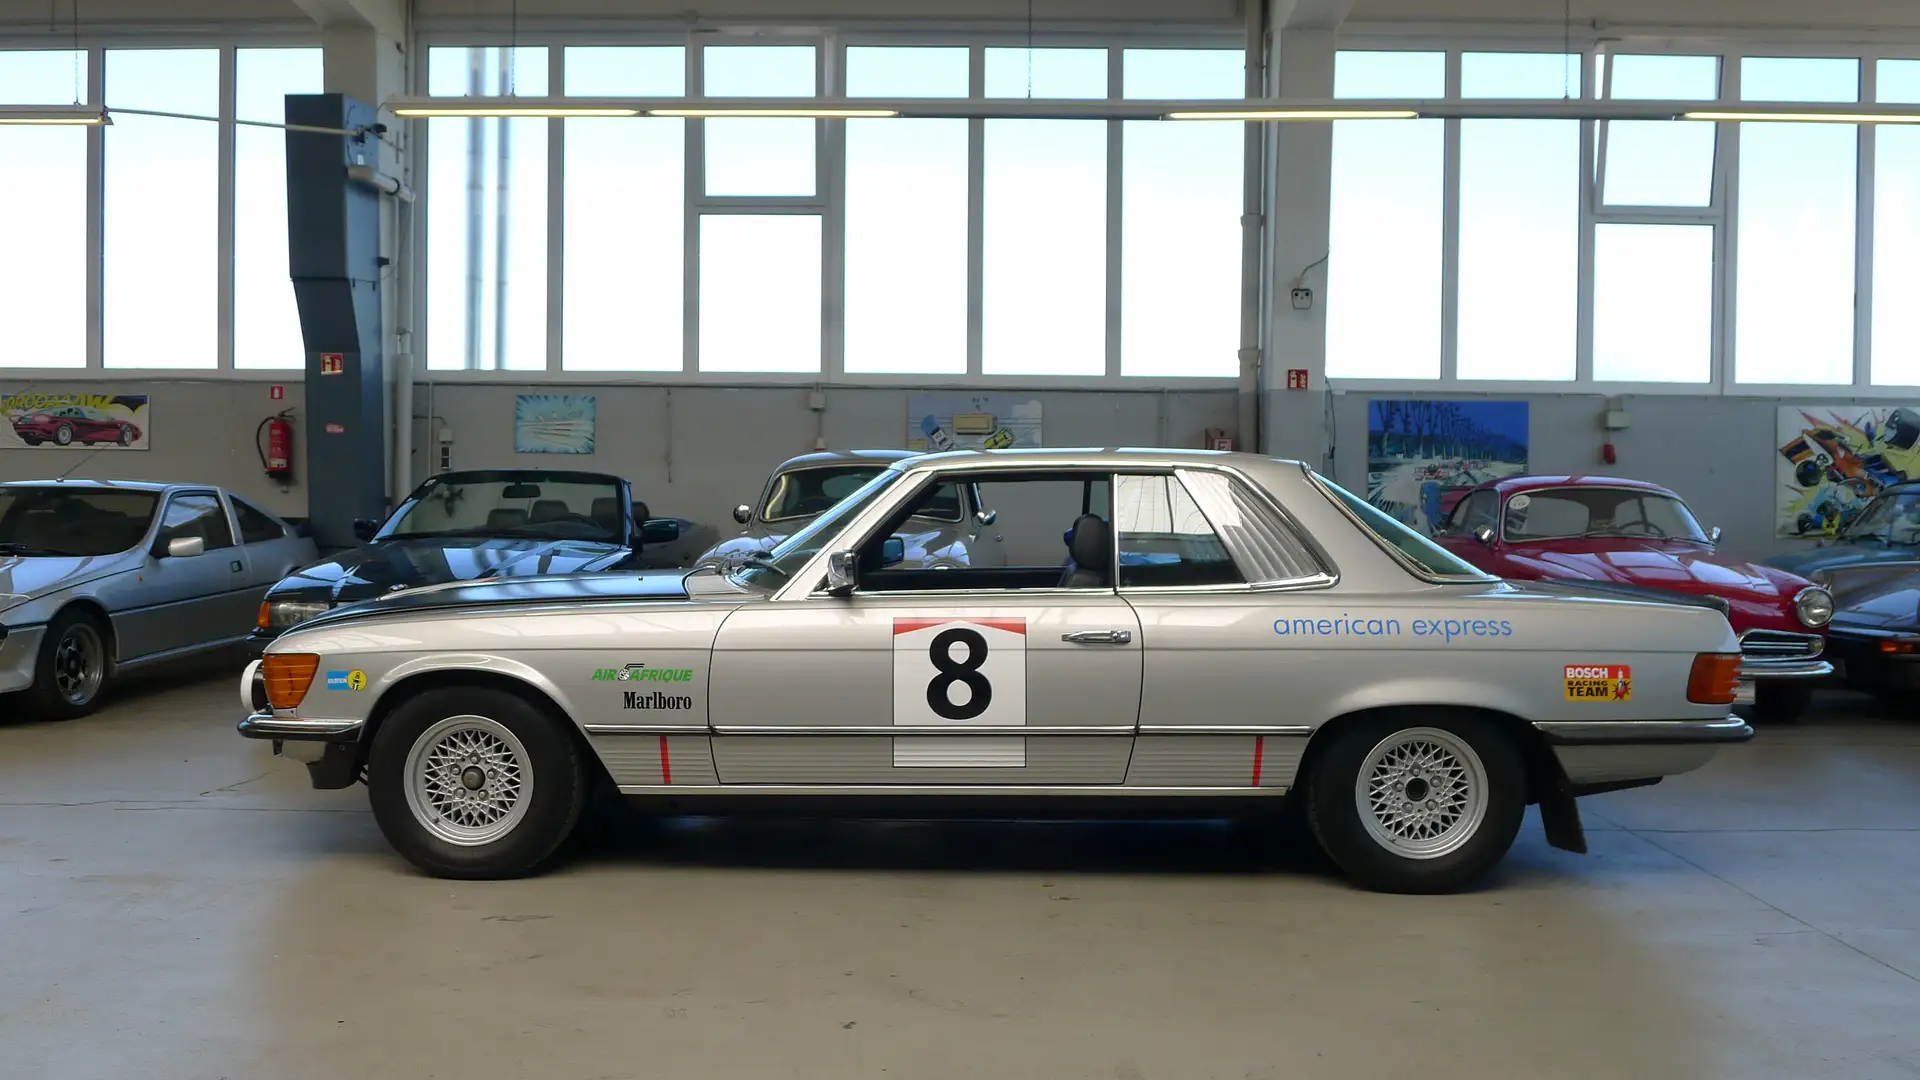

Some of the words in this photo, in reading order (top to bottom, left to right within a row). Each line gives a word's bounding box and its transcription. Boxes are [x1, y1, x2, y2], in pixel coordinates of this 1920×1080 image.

[1273, 613, 1401, 636] american
[1412, 619, 1513, 643] express
[591, 669, 617, 681] AIR
[629, 669, 693, 682] AFRIQUE
[926, 627, 992, 721] 8
[1566, 667, 1608, 679] BOSCH
[1567, 687, 1608, 697] TEAM
[623, 691, 692, 710] Marlboro
